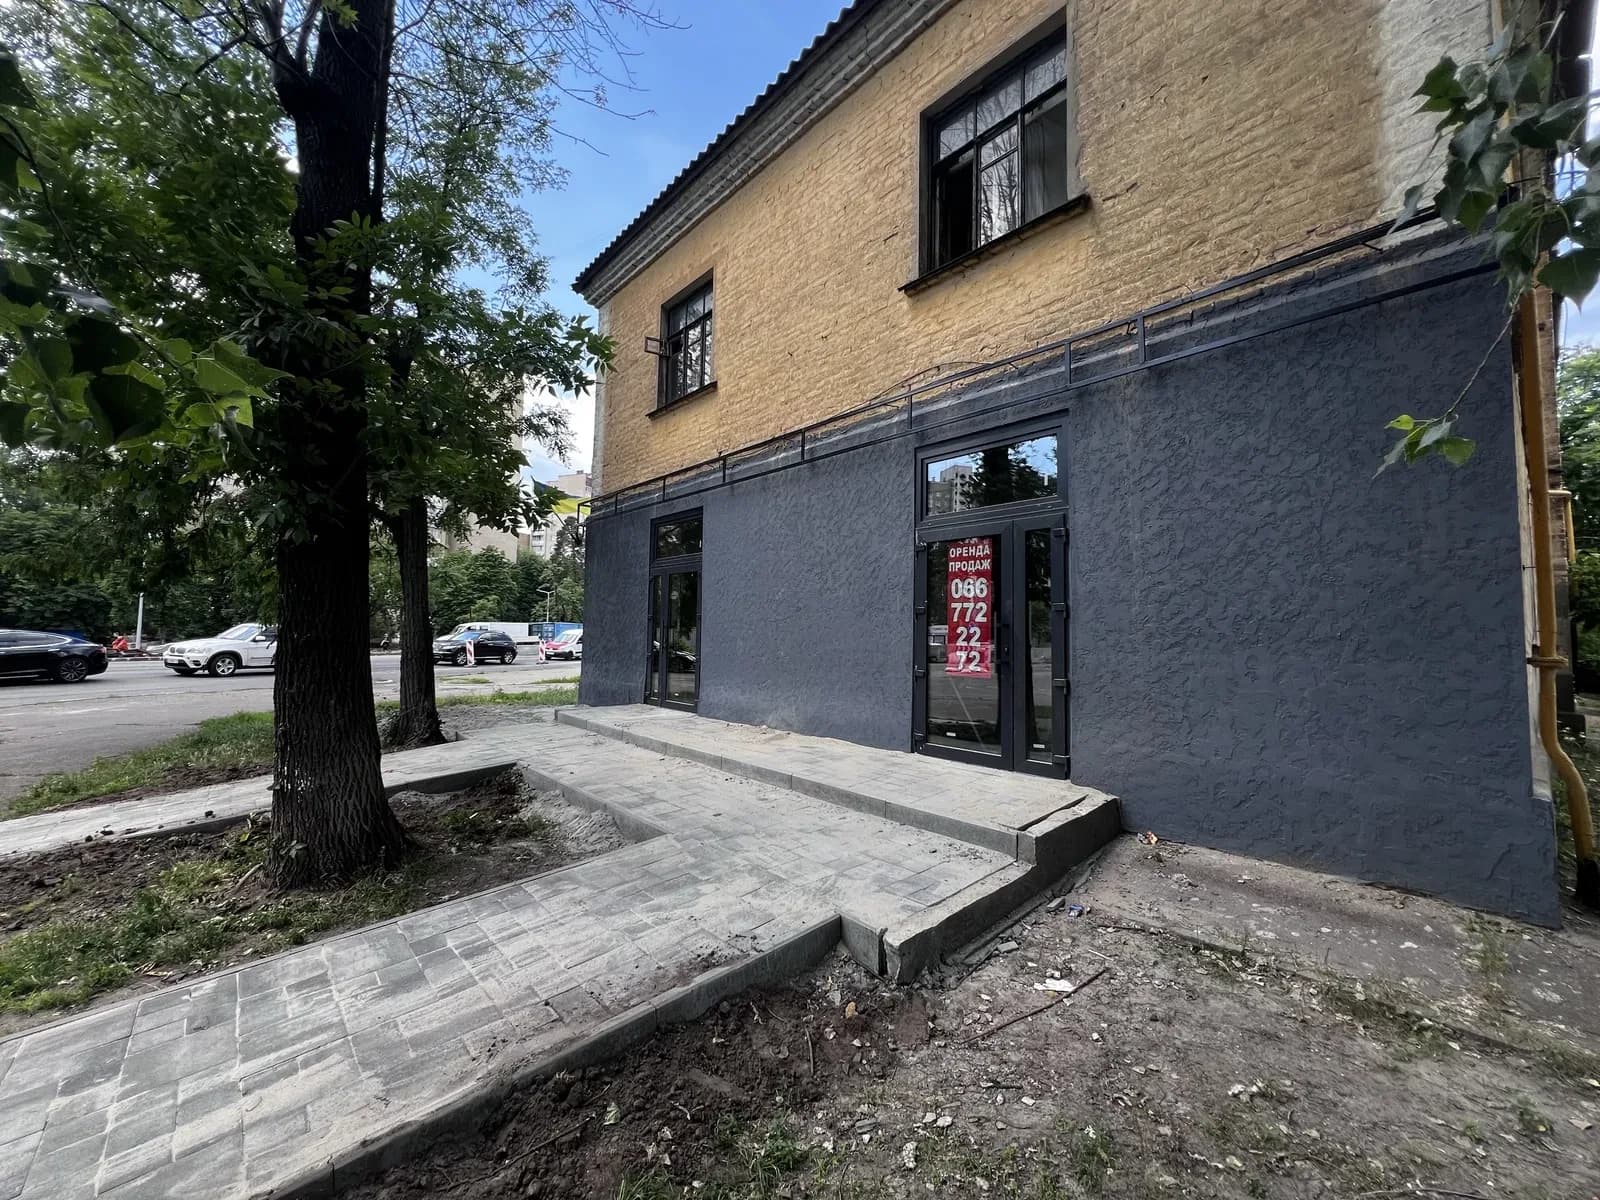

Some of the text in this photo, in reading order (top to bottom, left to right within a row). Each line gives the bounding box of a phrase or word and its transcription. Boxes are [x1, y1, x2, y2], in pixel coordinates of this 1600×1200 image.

[949, 544, 991, 558] ОРЕНДА
[948, 559, 991, 573] ПРОДАЖ
[951, 577, 988, 599] 066
[950, 601, 988, 623] 772
[955, 626, 981, 647] 22
[956, 650, 981, 672] 72
